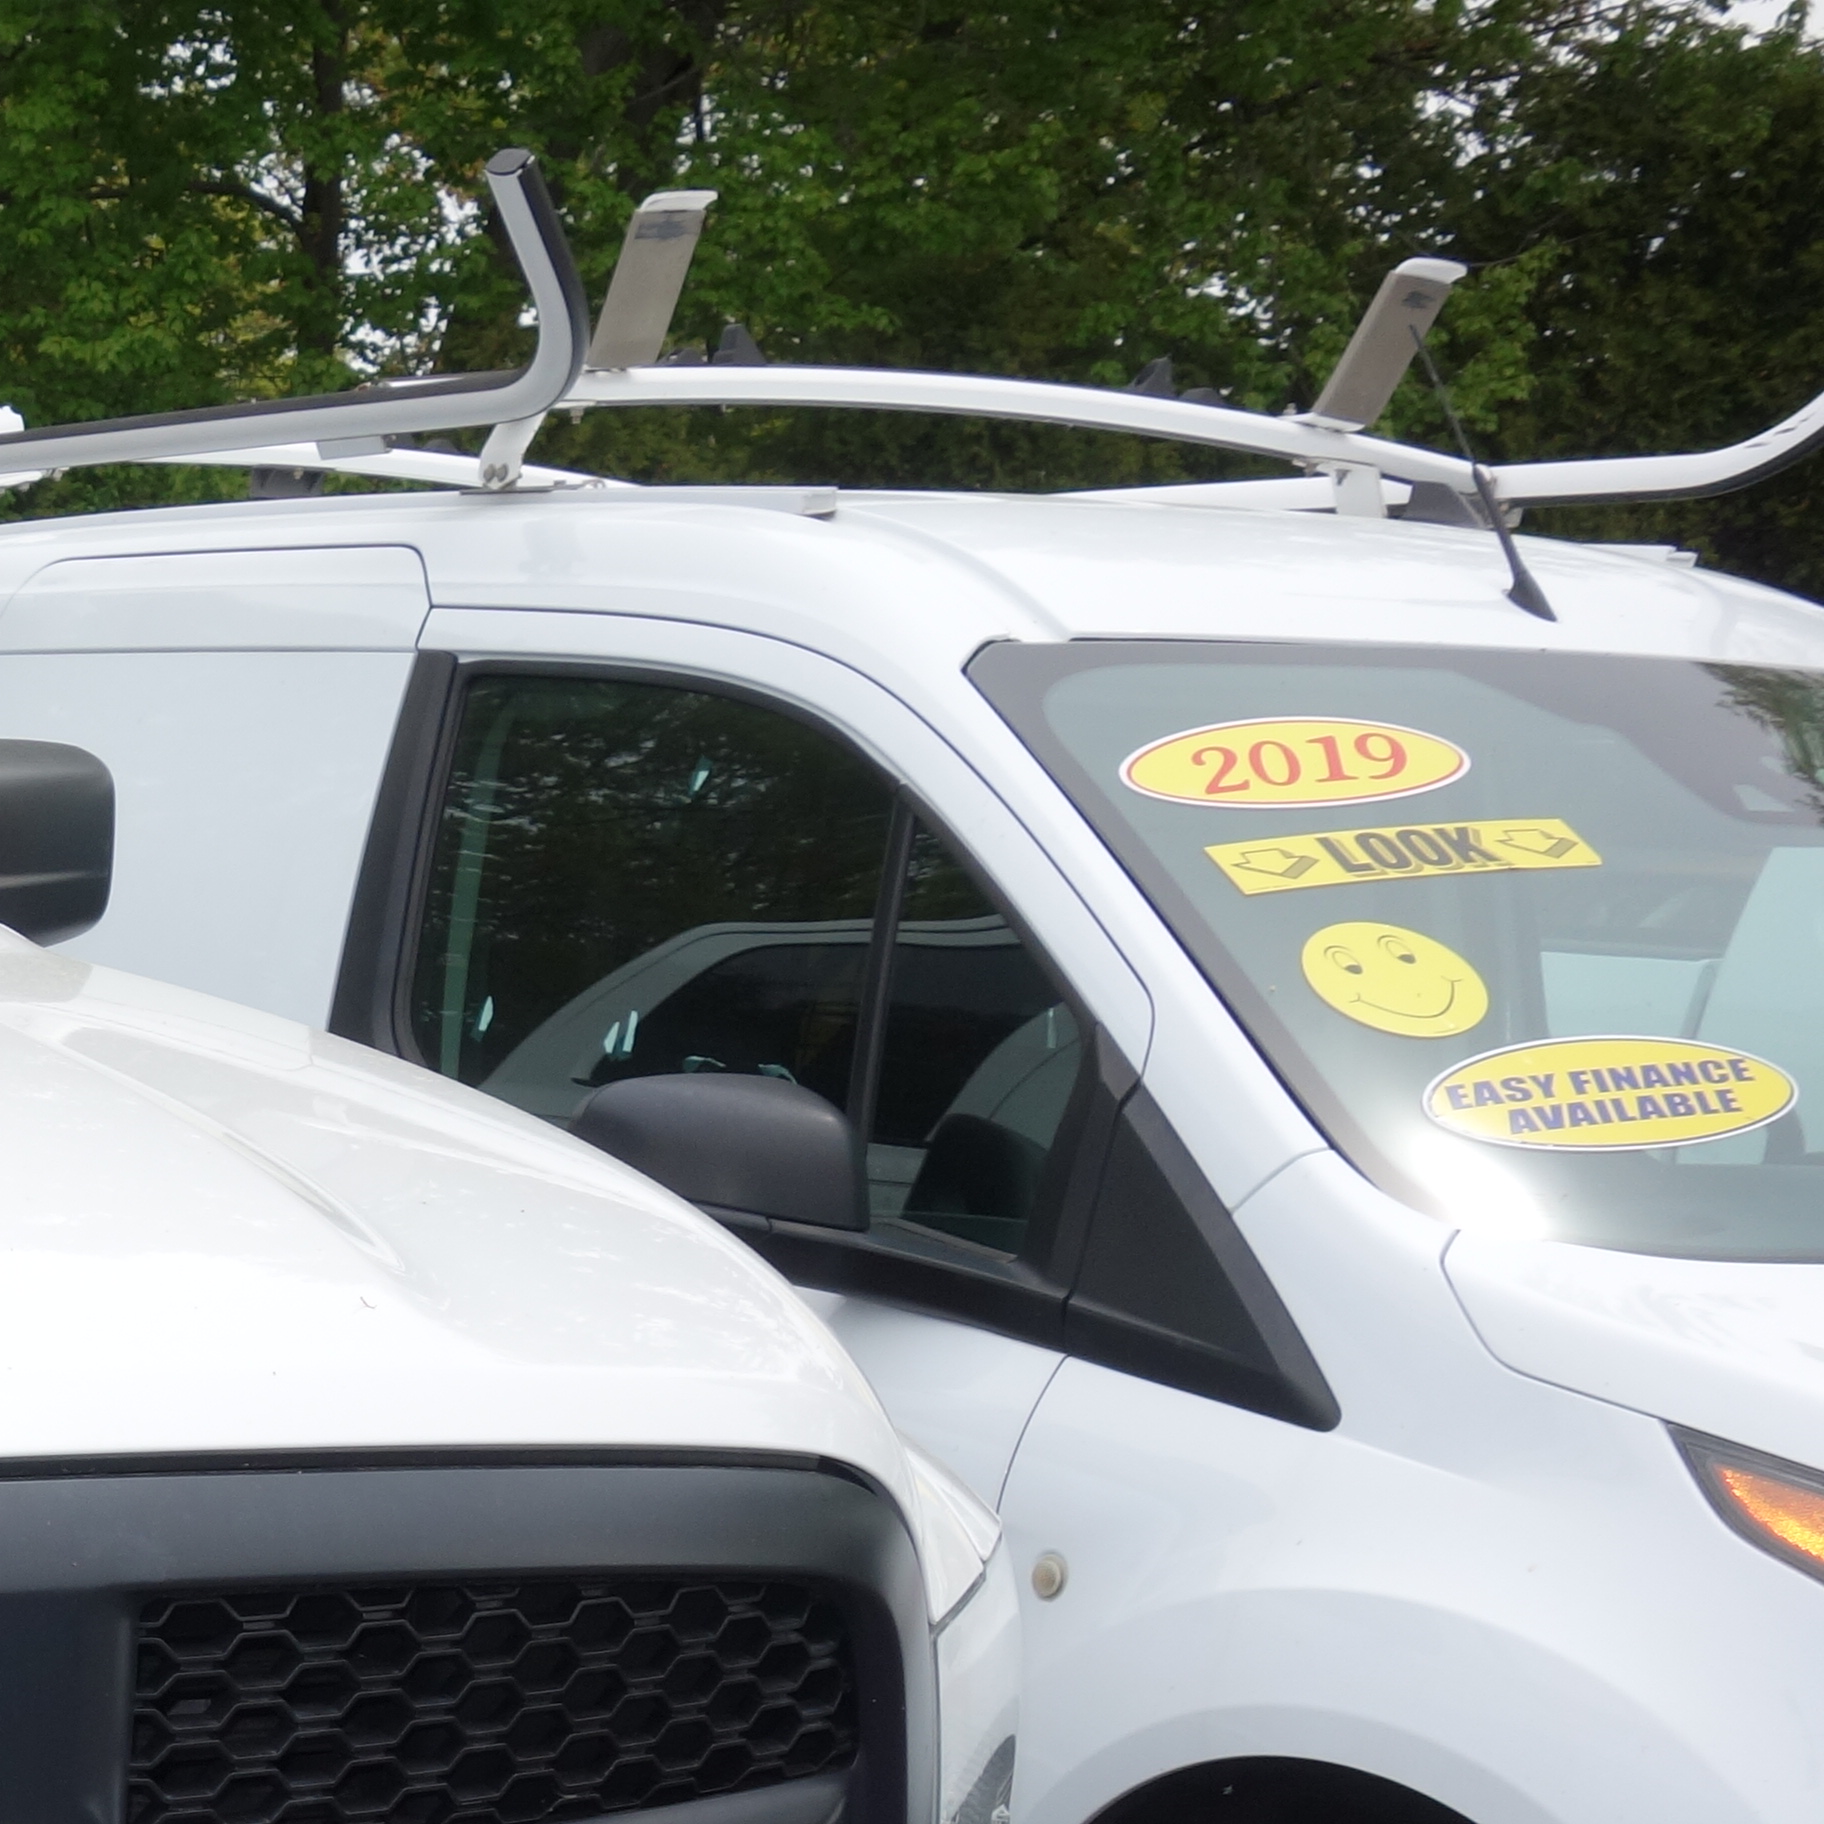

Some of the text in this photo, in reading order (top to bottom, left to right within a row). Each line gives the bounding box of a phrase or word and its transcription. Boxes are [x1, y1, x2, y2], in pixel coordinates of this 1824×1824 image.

[1192, 732, 1407, 795] 2019
[1317, 826, 1498, 878] LOOK
[1445, 1058, 1756, 1111] EASY FINANCE
[1509, 1089, 1744, 1135] AVAILABLE
